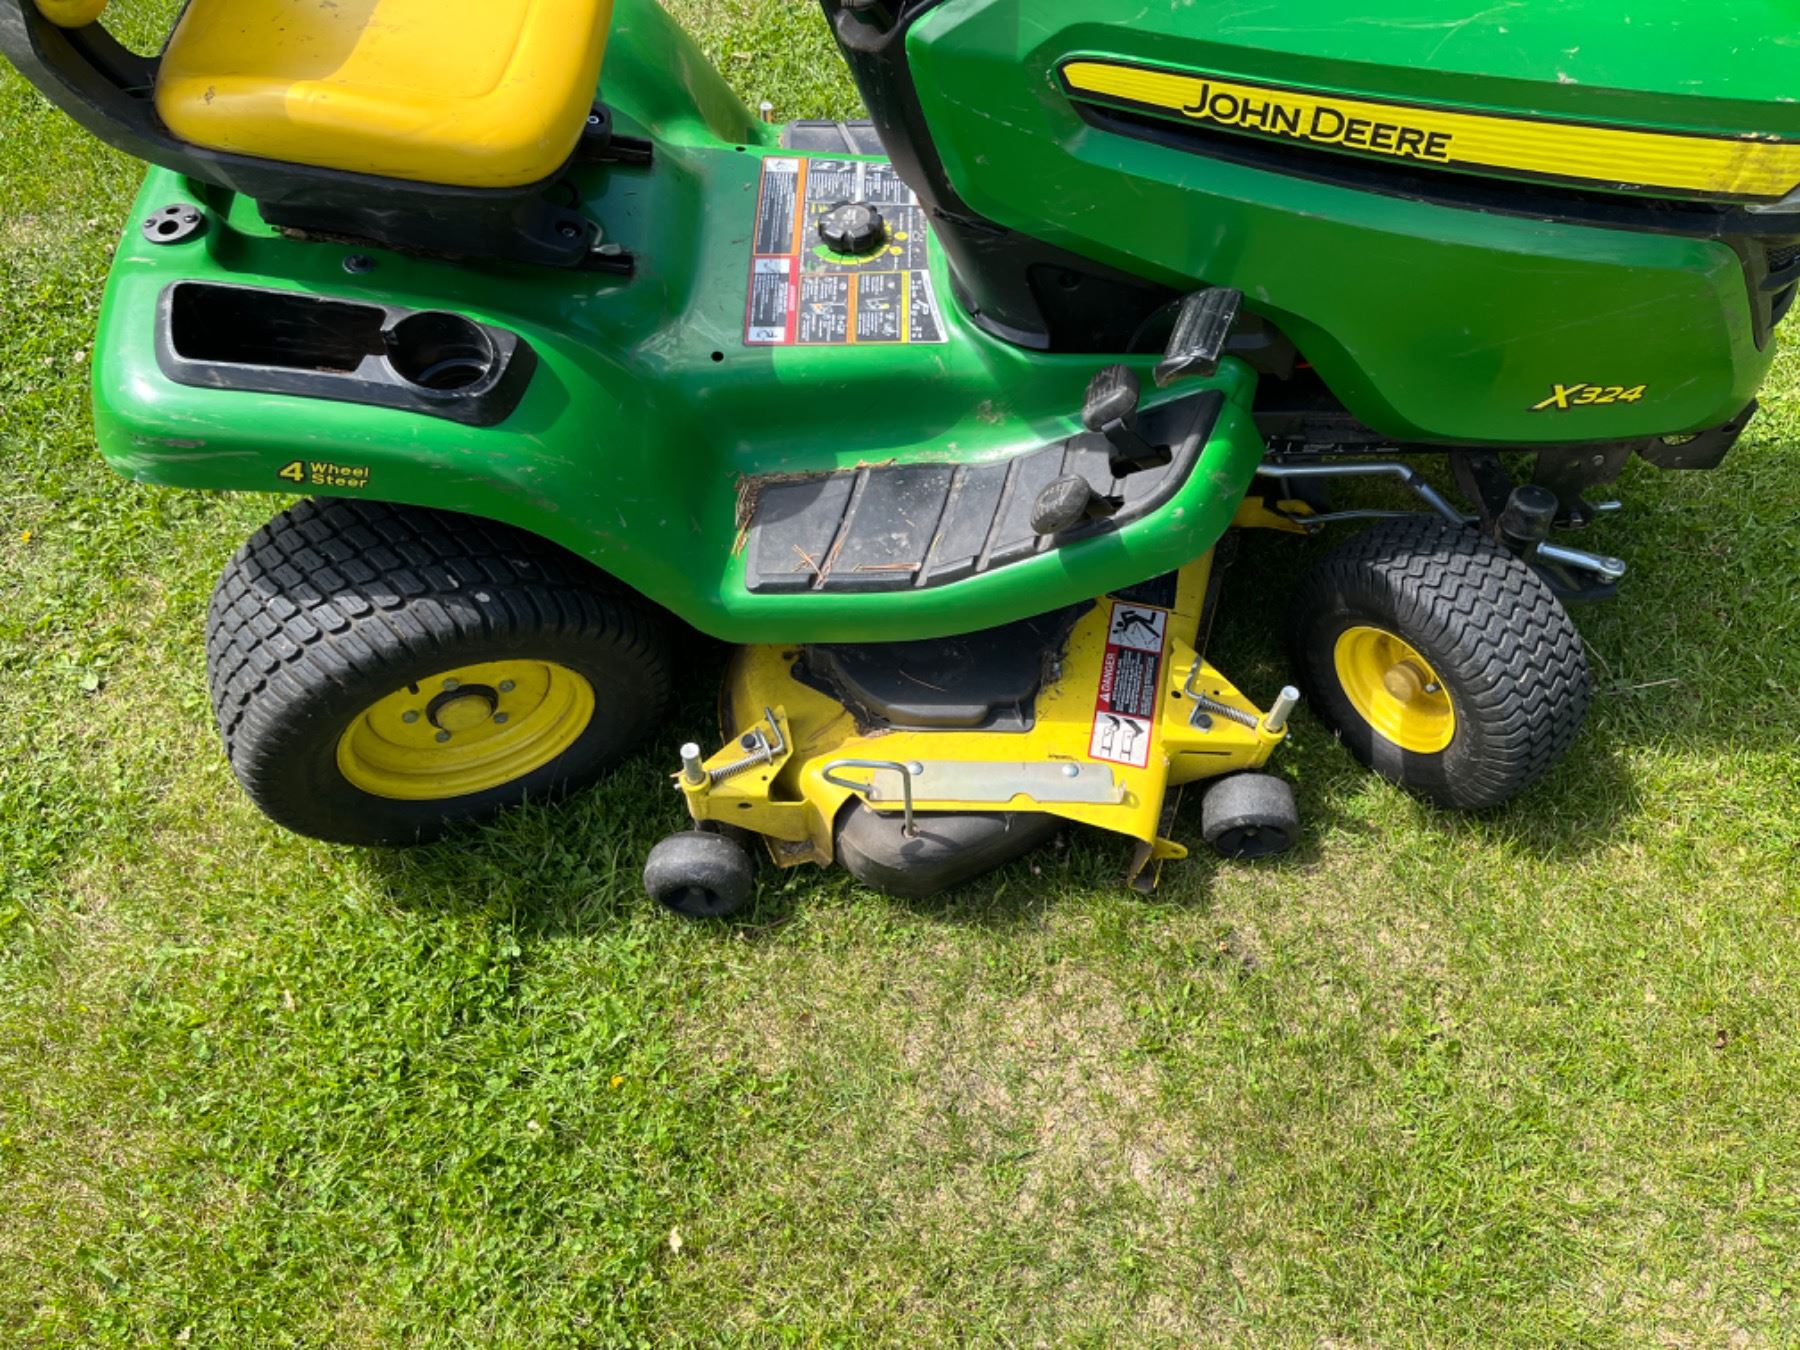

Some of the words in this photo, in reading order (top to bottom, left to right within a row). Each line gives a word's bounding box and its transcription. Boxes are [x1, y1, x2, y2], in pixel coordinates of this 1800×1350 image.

[1183, 83, 1302, 134] JOHN
[1310, 106, 1453, 159] DEERE
[1530, 383, 1647, 411] X324
[279, 461, 304, 482] 4
[310, 461, 369, 477] Wheel
[311, 473, 368, 488] Steer
[1101, 653, 1115, 692] DANGER
